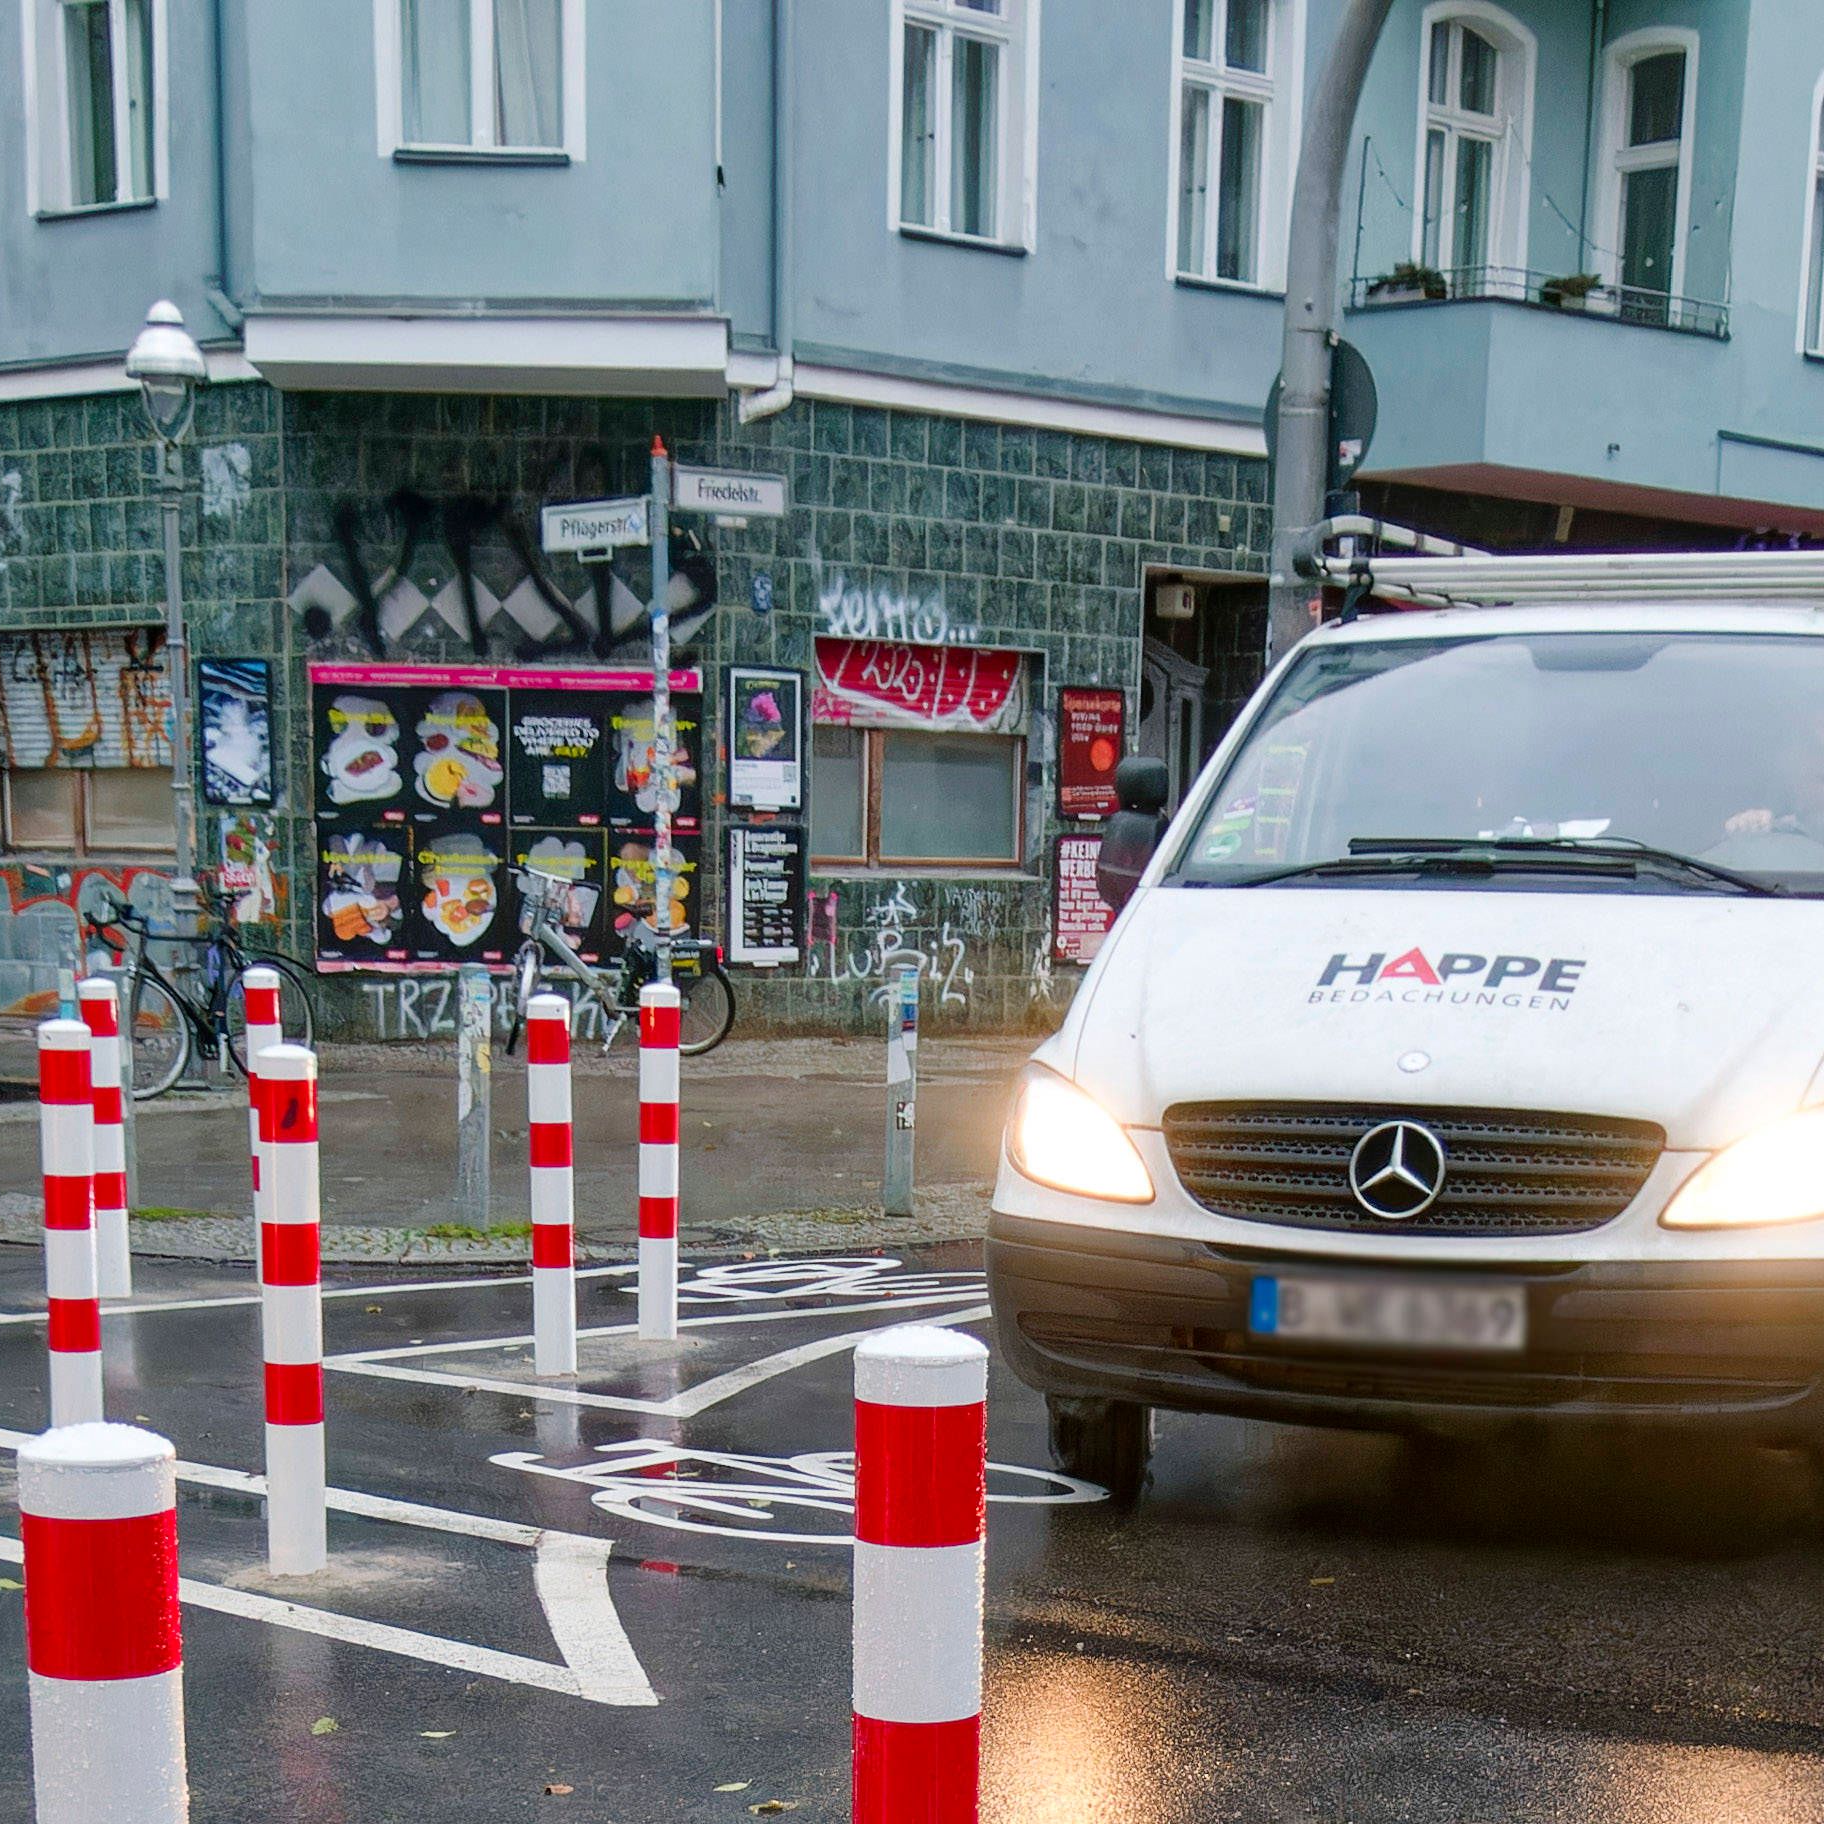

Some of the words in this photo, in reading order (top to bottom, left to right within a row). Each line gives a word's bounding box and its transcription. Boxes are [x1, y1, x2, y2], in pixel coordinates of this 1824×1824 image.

[697, 478, 762, 504] Friedelstr.
[1315, 946, 1587, 993] HAPPE
[1307, 989, 1571, 1011] BEDACHUNGEN
